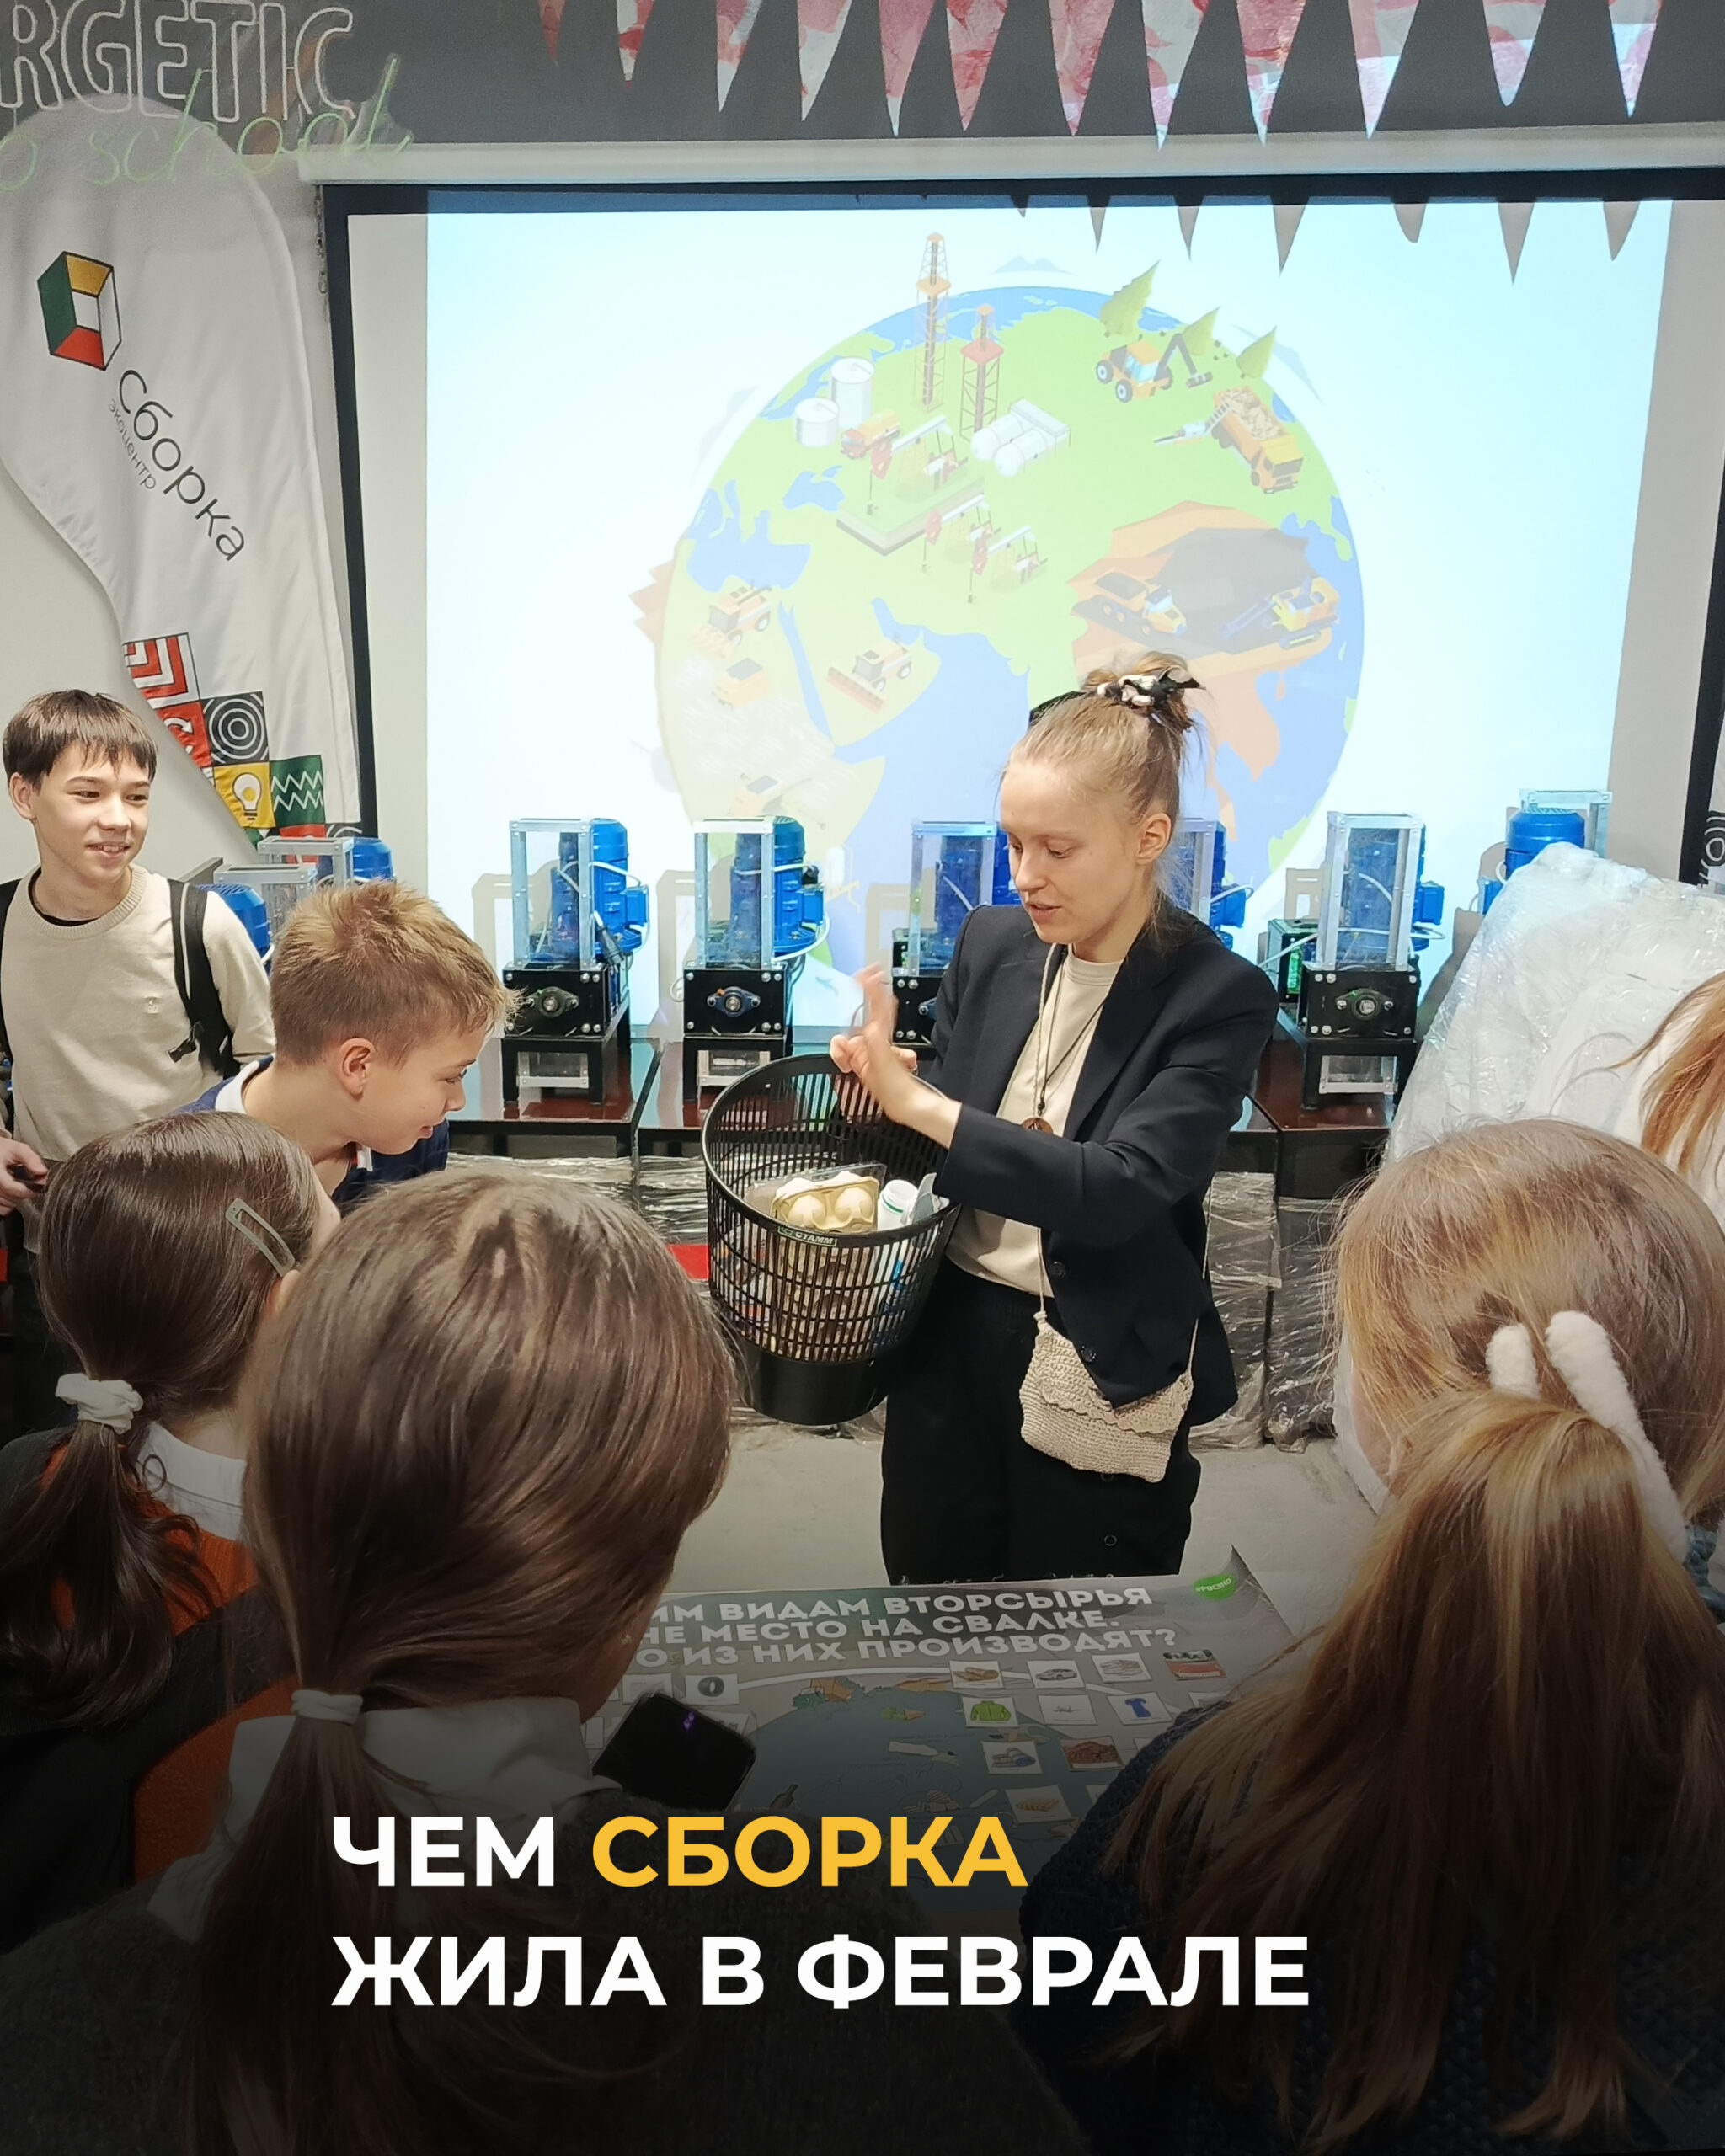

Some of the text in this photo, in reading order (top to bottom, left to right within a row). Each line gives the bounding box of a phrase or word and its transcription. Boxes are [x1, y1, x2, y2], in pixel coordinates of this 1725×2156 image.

[107, 398, 157, 490] экоцентр
[119, 370, 245, 561] Сборка
[794, 1230, 834, 1245] СТАММ
[719, 1598, 870, 1621] ВИДАМ
[884, 1588, 1153, 1615] ВТОРСЫРЬЯ
[701, 1620, 848, 1643] МЕСТО
[861, 1617, 923, 1637] НА
[932, 1610, 1120, 1634] СВАЛКЕ.
[682, 1646, 740, 1666] ИЗ
[752, 1642, 846, 1663] НИХ
[857, 1628, 1176, 1659] ПРОИЗВОДЯТ?
